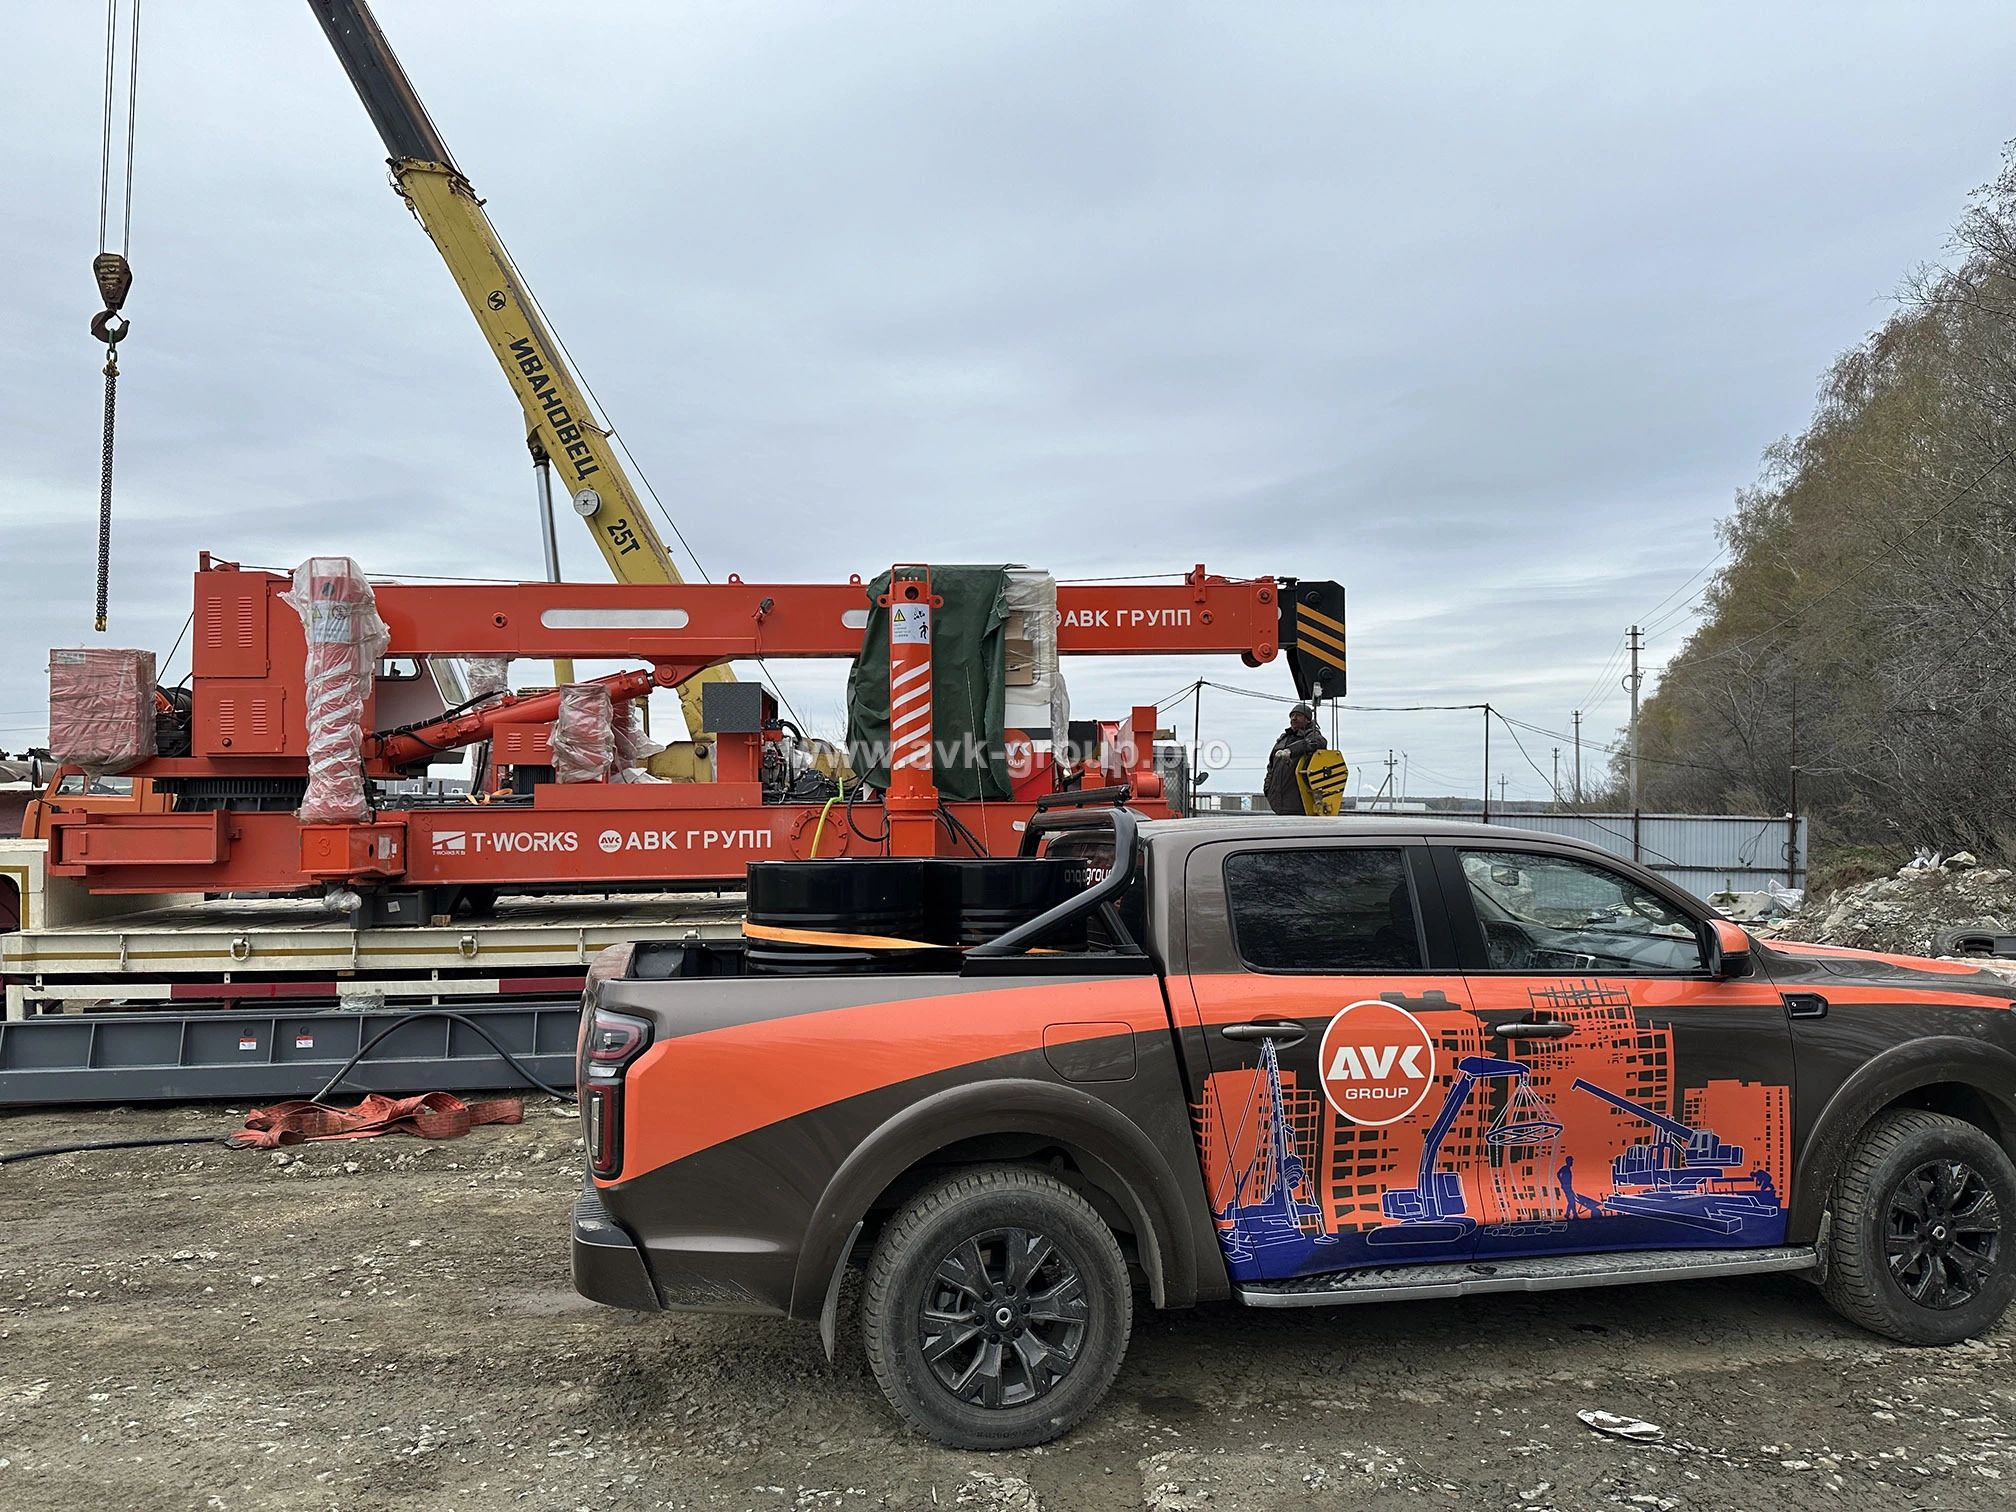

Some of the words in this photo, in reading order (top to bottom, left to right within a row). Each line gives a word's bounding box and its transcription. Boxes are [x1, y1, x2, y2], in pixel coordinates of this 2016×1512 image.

[509, 337, 600, 481] ИВАНОВЕЦ
[606, 518, 641, 556] 25Т
[1064, 610, 1110, 627] АВК
[1116, 609, 1191, 627] ГРУПП
[1004, 742, 1031, 757] VK
[625, 831, 678, 850] АВК
[686, 830, 772, 849] ГРУПП
[1326, 1045, 1426, 1080] AVK
[1345, 1087, 1409, 1099] GROUP
